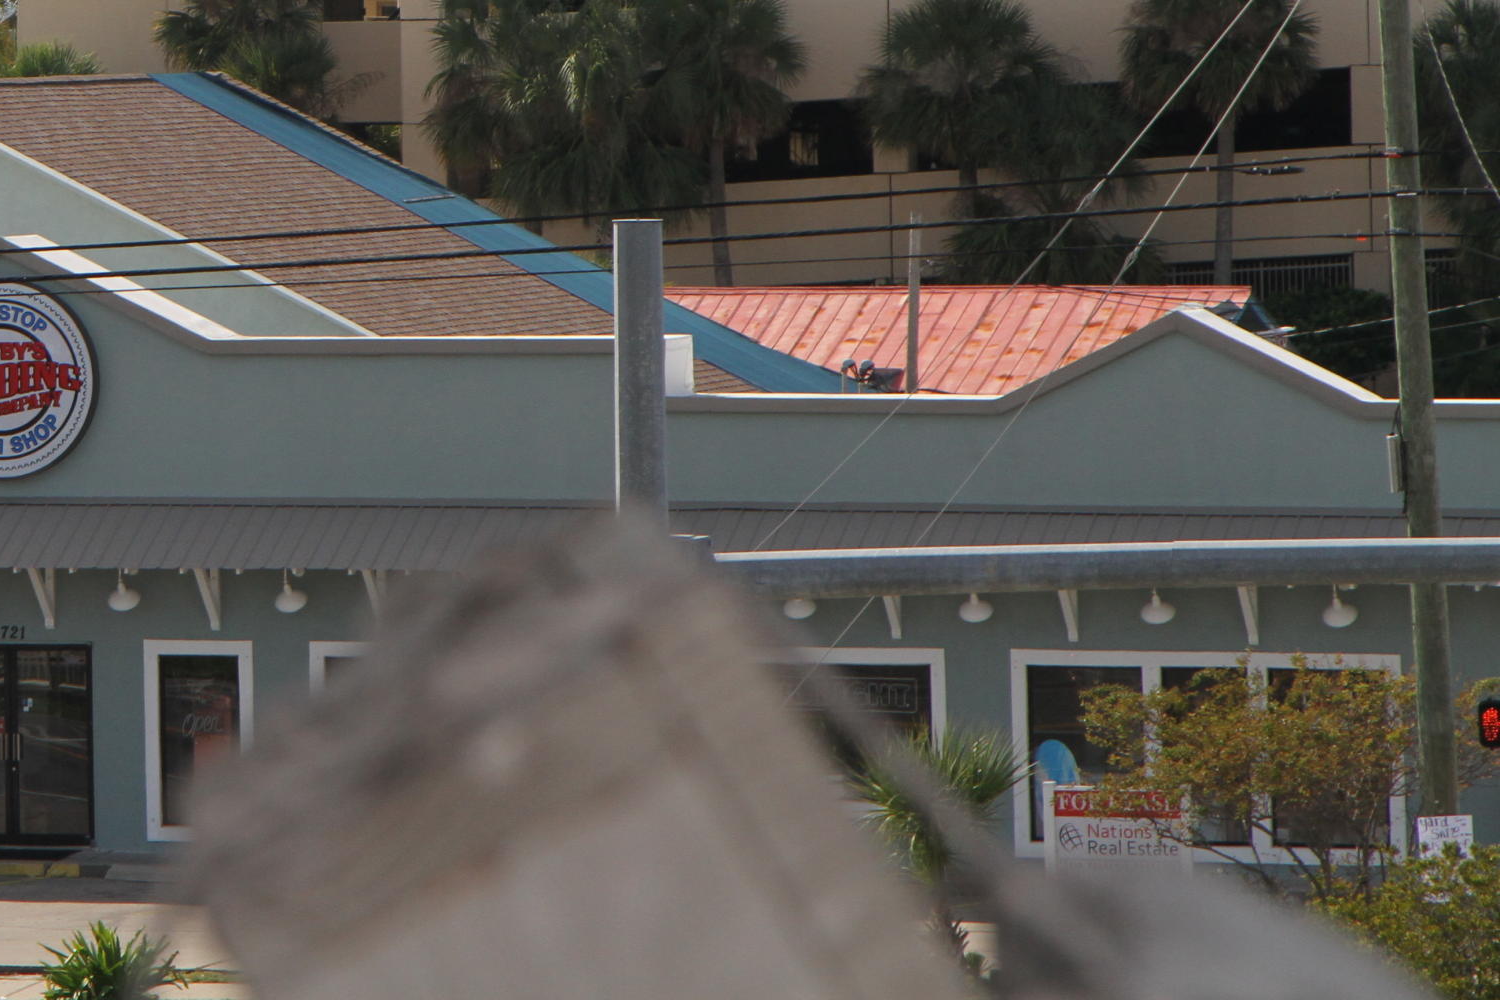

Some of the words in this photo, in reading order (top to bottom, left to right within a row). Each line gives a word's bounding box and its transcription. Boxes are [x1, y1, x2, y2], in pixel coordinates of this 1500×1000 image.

[10, 413, 58, 454] SHOP
[1087, 823, 1153, 840] Nations
[1087, 840, 1122, 856] Real
[1126, 840, 1180, 857] Estate
